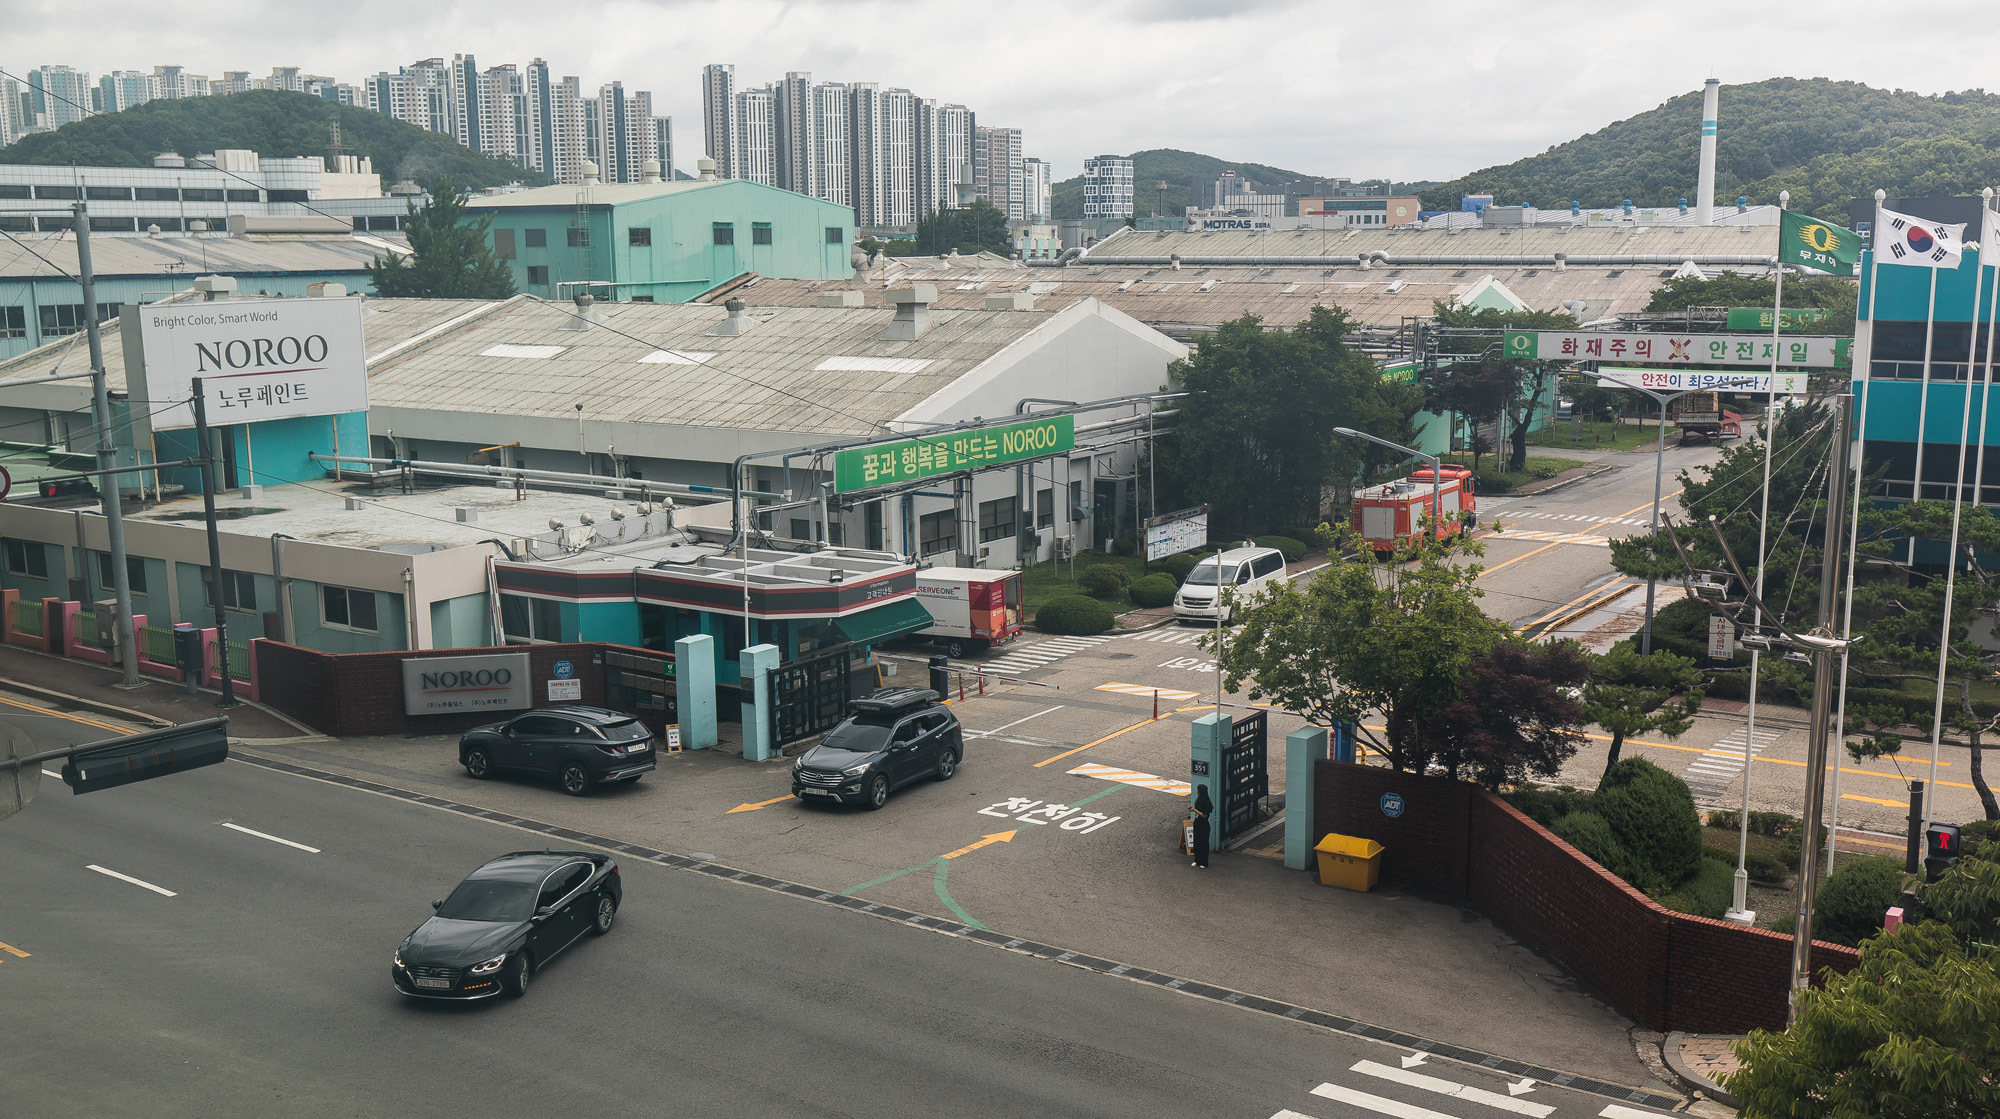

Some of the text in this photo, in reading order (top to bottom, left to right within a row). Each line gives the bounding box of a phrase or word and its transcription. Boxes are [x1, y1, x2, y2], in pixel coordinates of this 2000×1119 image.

[1204, 220, 1251, 229] MOTRAS
[154, 311, 278, 329] Bright Color, Smart World
[194, 334, 328, 372] NOROO
[1561, 337, 1652, 359] 화재주의
[1641, 373, 1681, 388] 안전이
[218, 383, 309, 408] 노루페인트
[862, 424, 1057, 482] 꿈과 행복을 만드는 NOROO
[918, 585, 955, 595] SERVEONE
[421, 668, 512, 689] NOROO
[1194, 764, 1206, 773] 351
[1384, 800, 1400, 810] ADT
[977, 797, 1121, 834] 천천히
